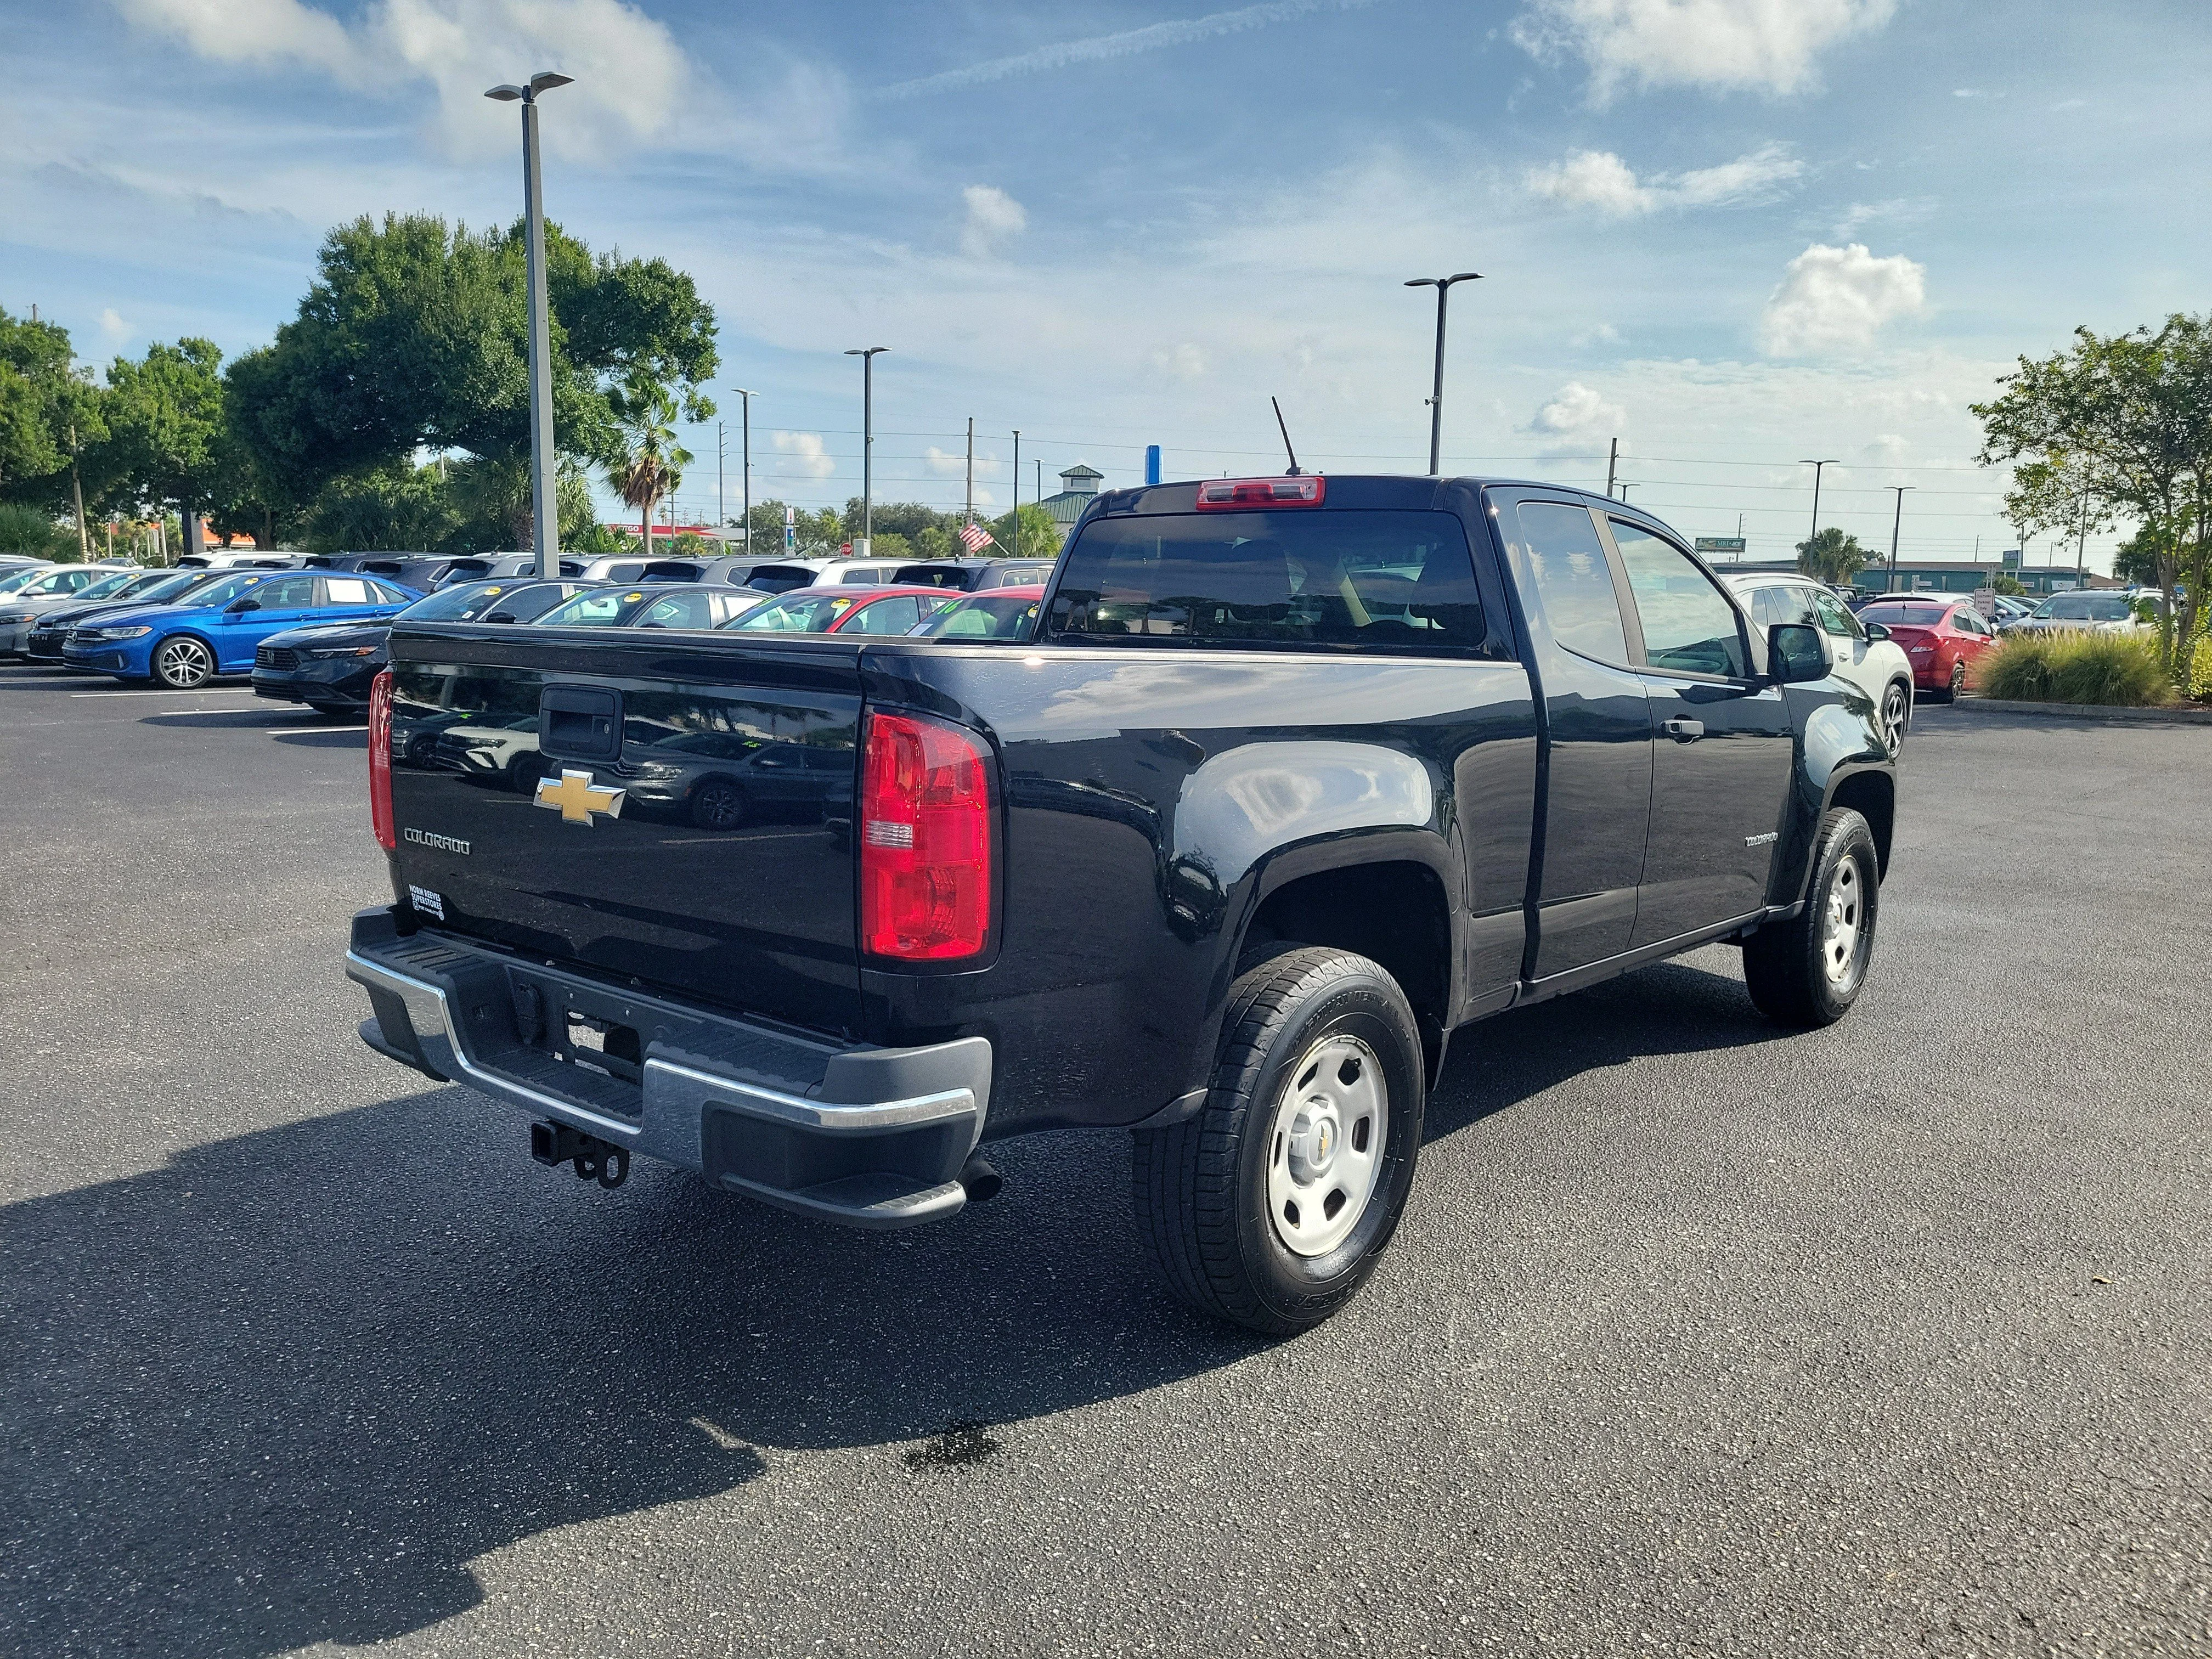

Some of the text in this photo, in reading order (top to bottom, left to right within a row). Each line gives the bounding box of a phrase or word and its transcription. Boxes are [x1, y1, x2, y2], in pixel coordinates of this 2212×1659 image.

[936, 599, 963, 614] 16
[404, 827, 470, 855] COLORADO
[1745, 832, 1778, 847] COLORADO
[409, 883, 441, 902] NORM REEVES
[411, 892, 442, 910] SUPERSTORES
